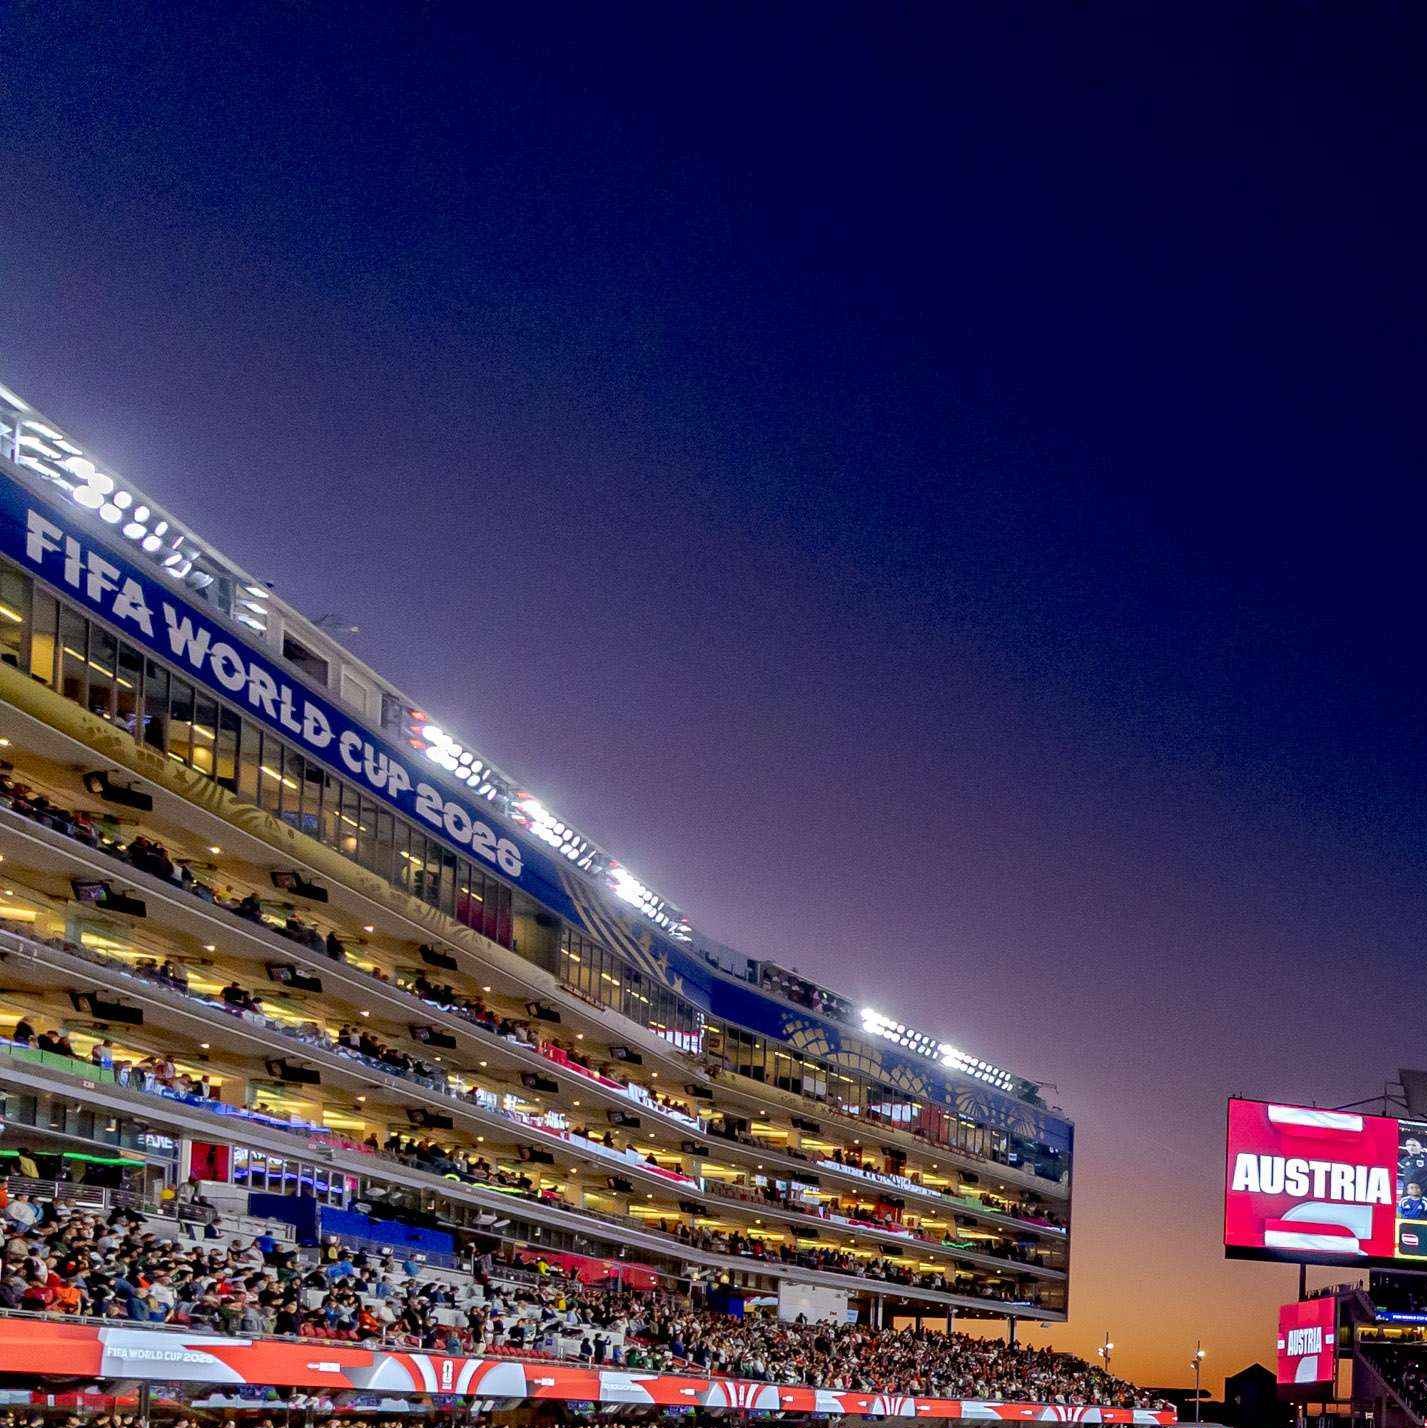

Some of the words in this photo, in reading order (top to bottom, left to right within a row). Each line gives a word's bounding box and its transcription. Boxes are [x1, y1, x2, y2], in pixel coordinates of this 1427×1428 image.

[26, 508, 153, 639] FIFA
[164, 601, 332, 750] WORLD
[339, 730, 414, 800] CUP
[415, 781, 524, 879] 2026
[1232, 1153, 1392, 1205] AUSTRIA
[107, 1347, 129, 1358] FIFA
[130, 1349, 163, 1361] WORLD
[164, 1352, 183, 1362] CUP
[1287, 1327, 1322, 1356] AUSTRIA
